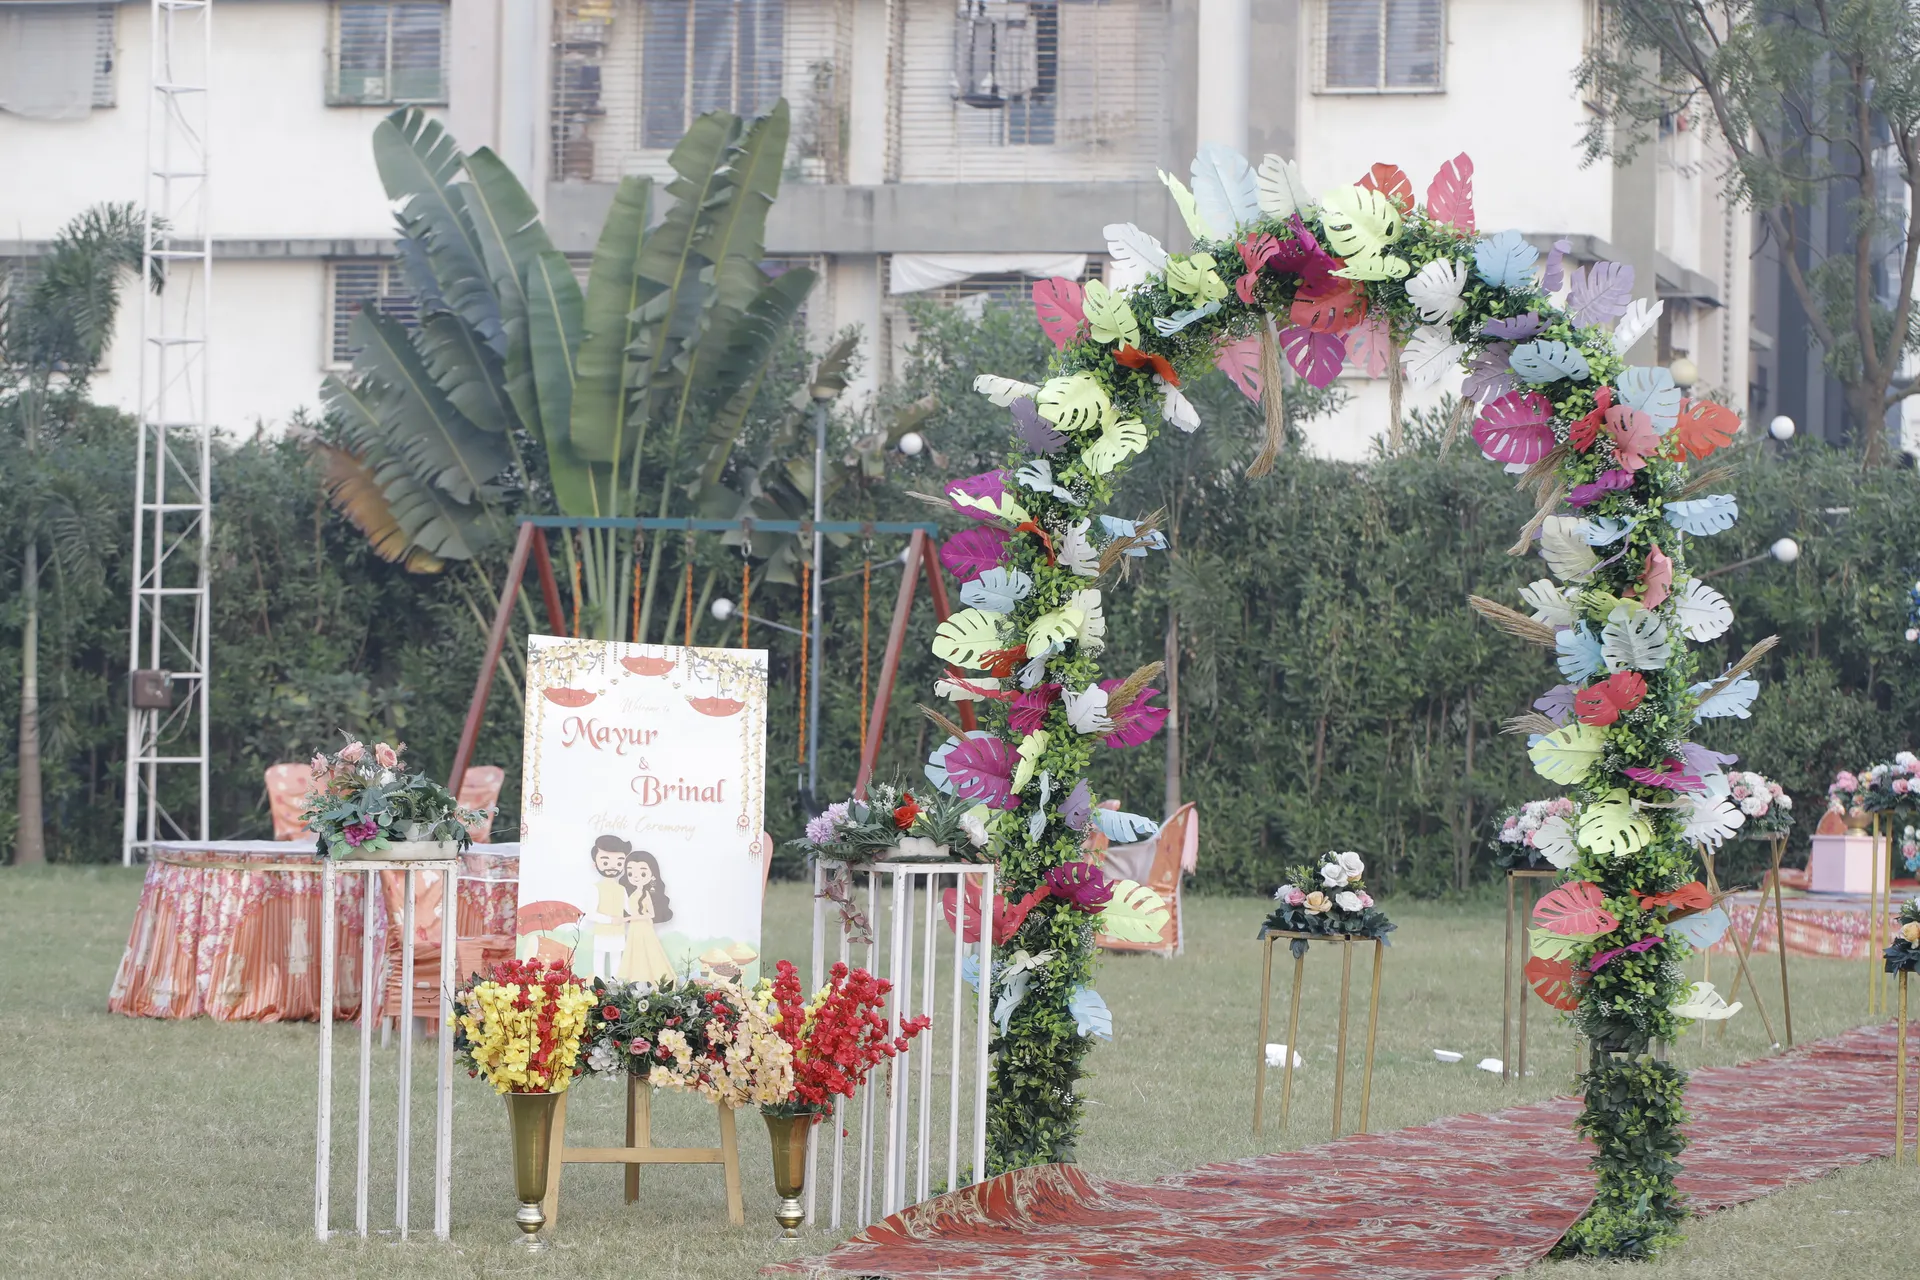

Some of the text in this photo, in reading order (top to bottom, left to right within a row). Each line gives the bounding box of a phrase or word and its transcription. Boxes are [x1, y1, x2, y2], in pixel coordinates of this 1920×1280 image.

[562, 716, 658, 756] Mayur
[638, 757, 650, 771] &
[631, 775, 726, 807] Brinal
[588, 812, 697, 841] Haldi Ceremony
